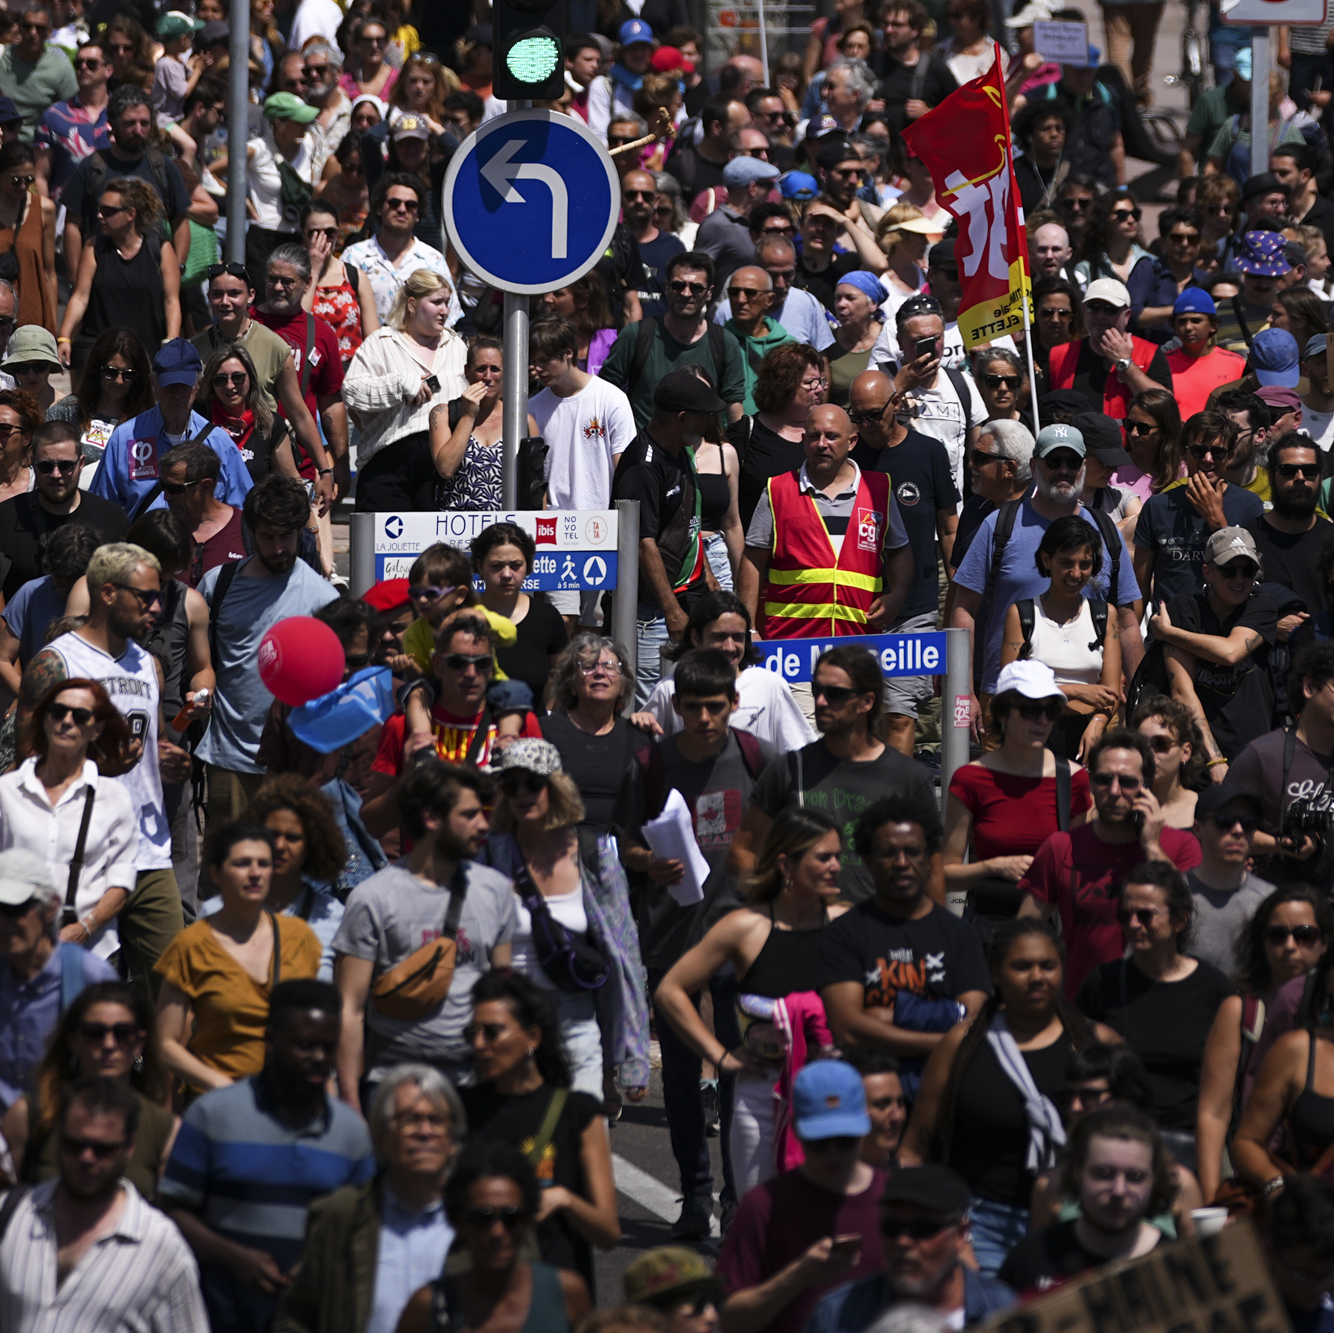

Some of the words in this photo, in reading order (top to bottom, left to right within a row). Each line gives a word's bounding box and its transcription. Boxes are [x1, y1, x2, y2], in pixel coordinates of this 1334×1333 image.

[564, 516, 576, 524] NO
[537, 524, 555, 537] ibis
[564, 524, 576, 532] VO
[593, 522, 600, 531] TA
[593, 531, 600, 539] TA
[859, 523, 881, 543] cgt
[377, 543, 386, 552] LA
[388, 542, 420, 552] JOLIETTE
[557, 581, 562, 589] à
[563, 581, 568, 589] 5
[569, 581, 580, 589] min
[765, 651, 801, 679] de
